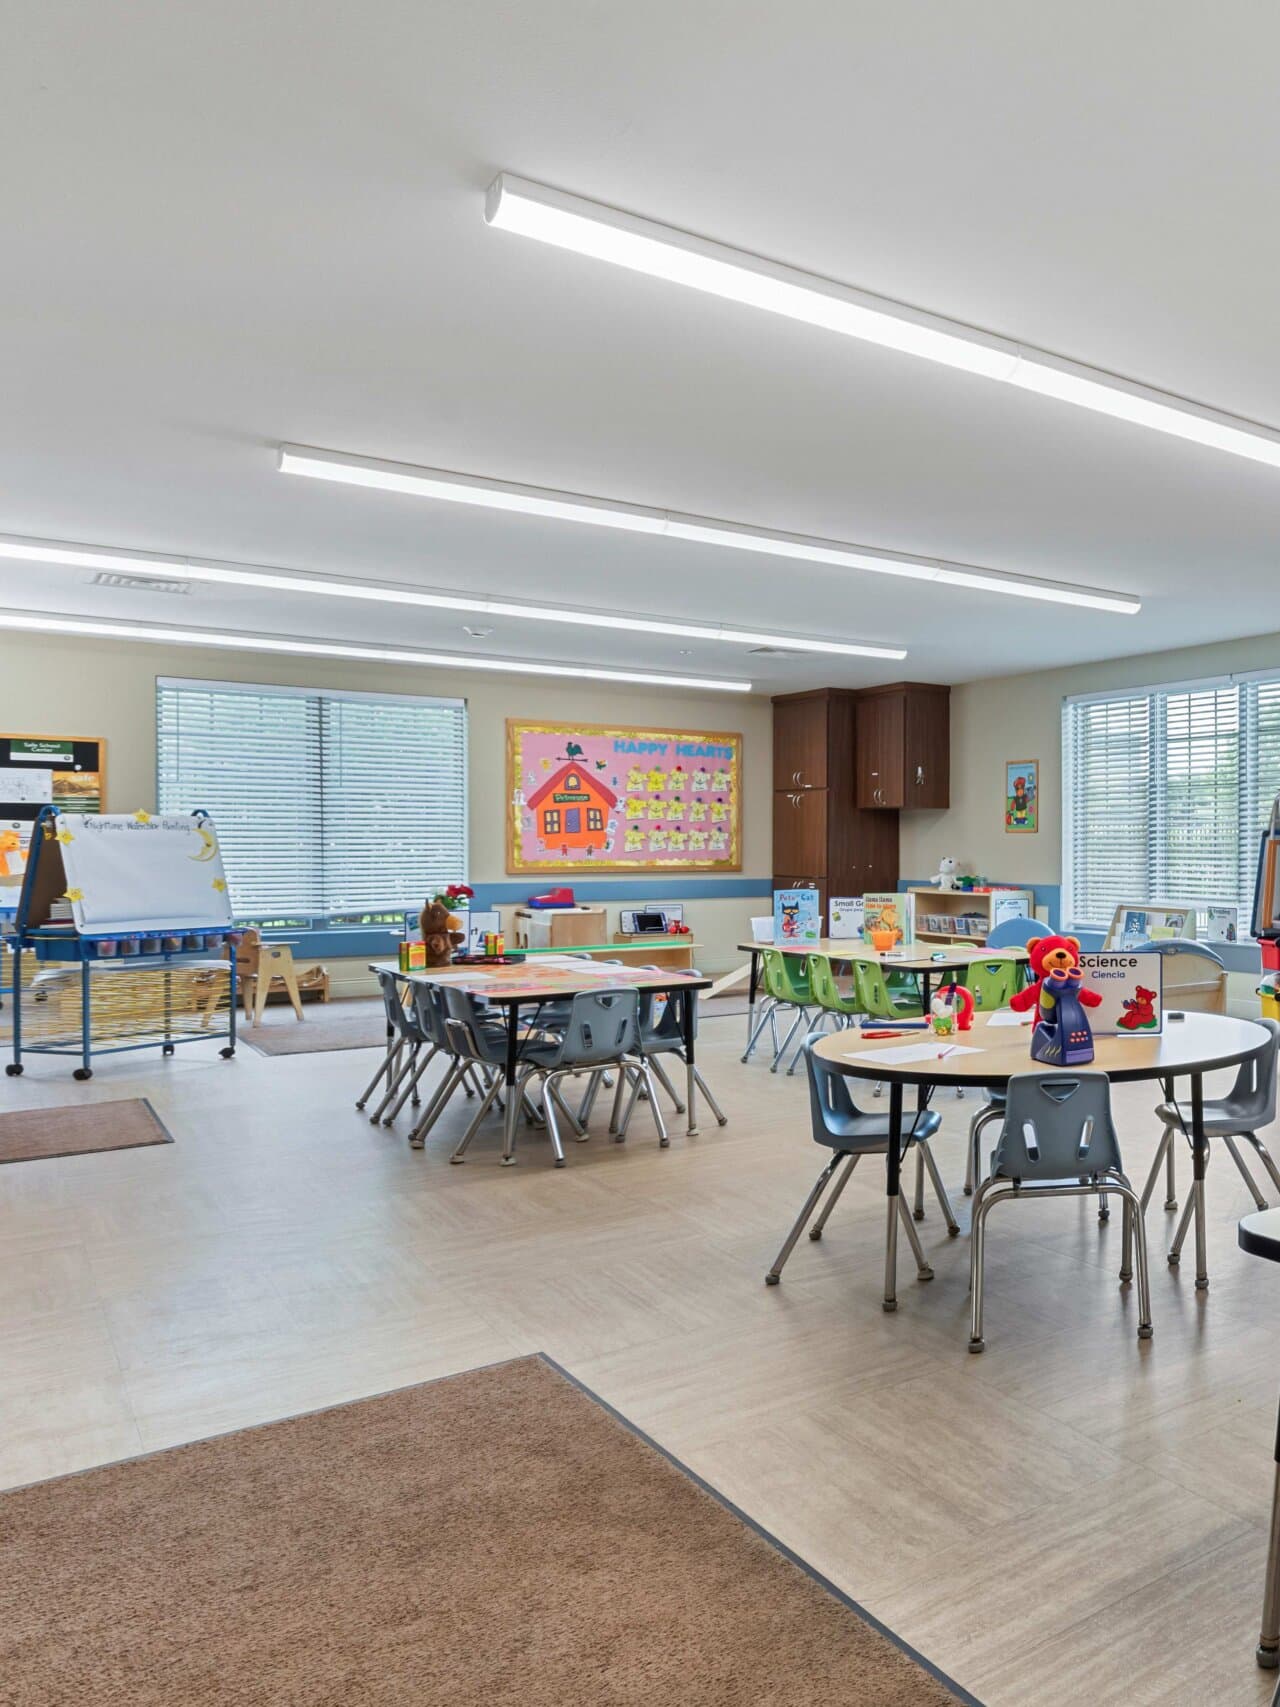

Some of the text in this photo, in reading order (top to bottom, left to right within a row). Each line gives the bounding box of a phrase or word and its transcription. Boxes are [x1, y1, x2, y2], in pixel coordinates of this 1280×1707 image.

[614, 740, 734, 760] HAPPY HEARTS
[1079, 956, 1138, 968] Science
[1092, 970, 1126, 979] Ciencia
